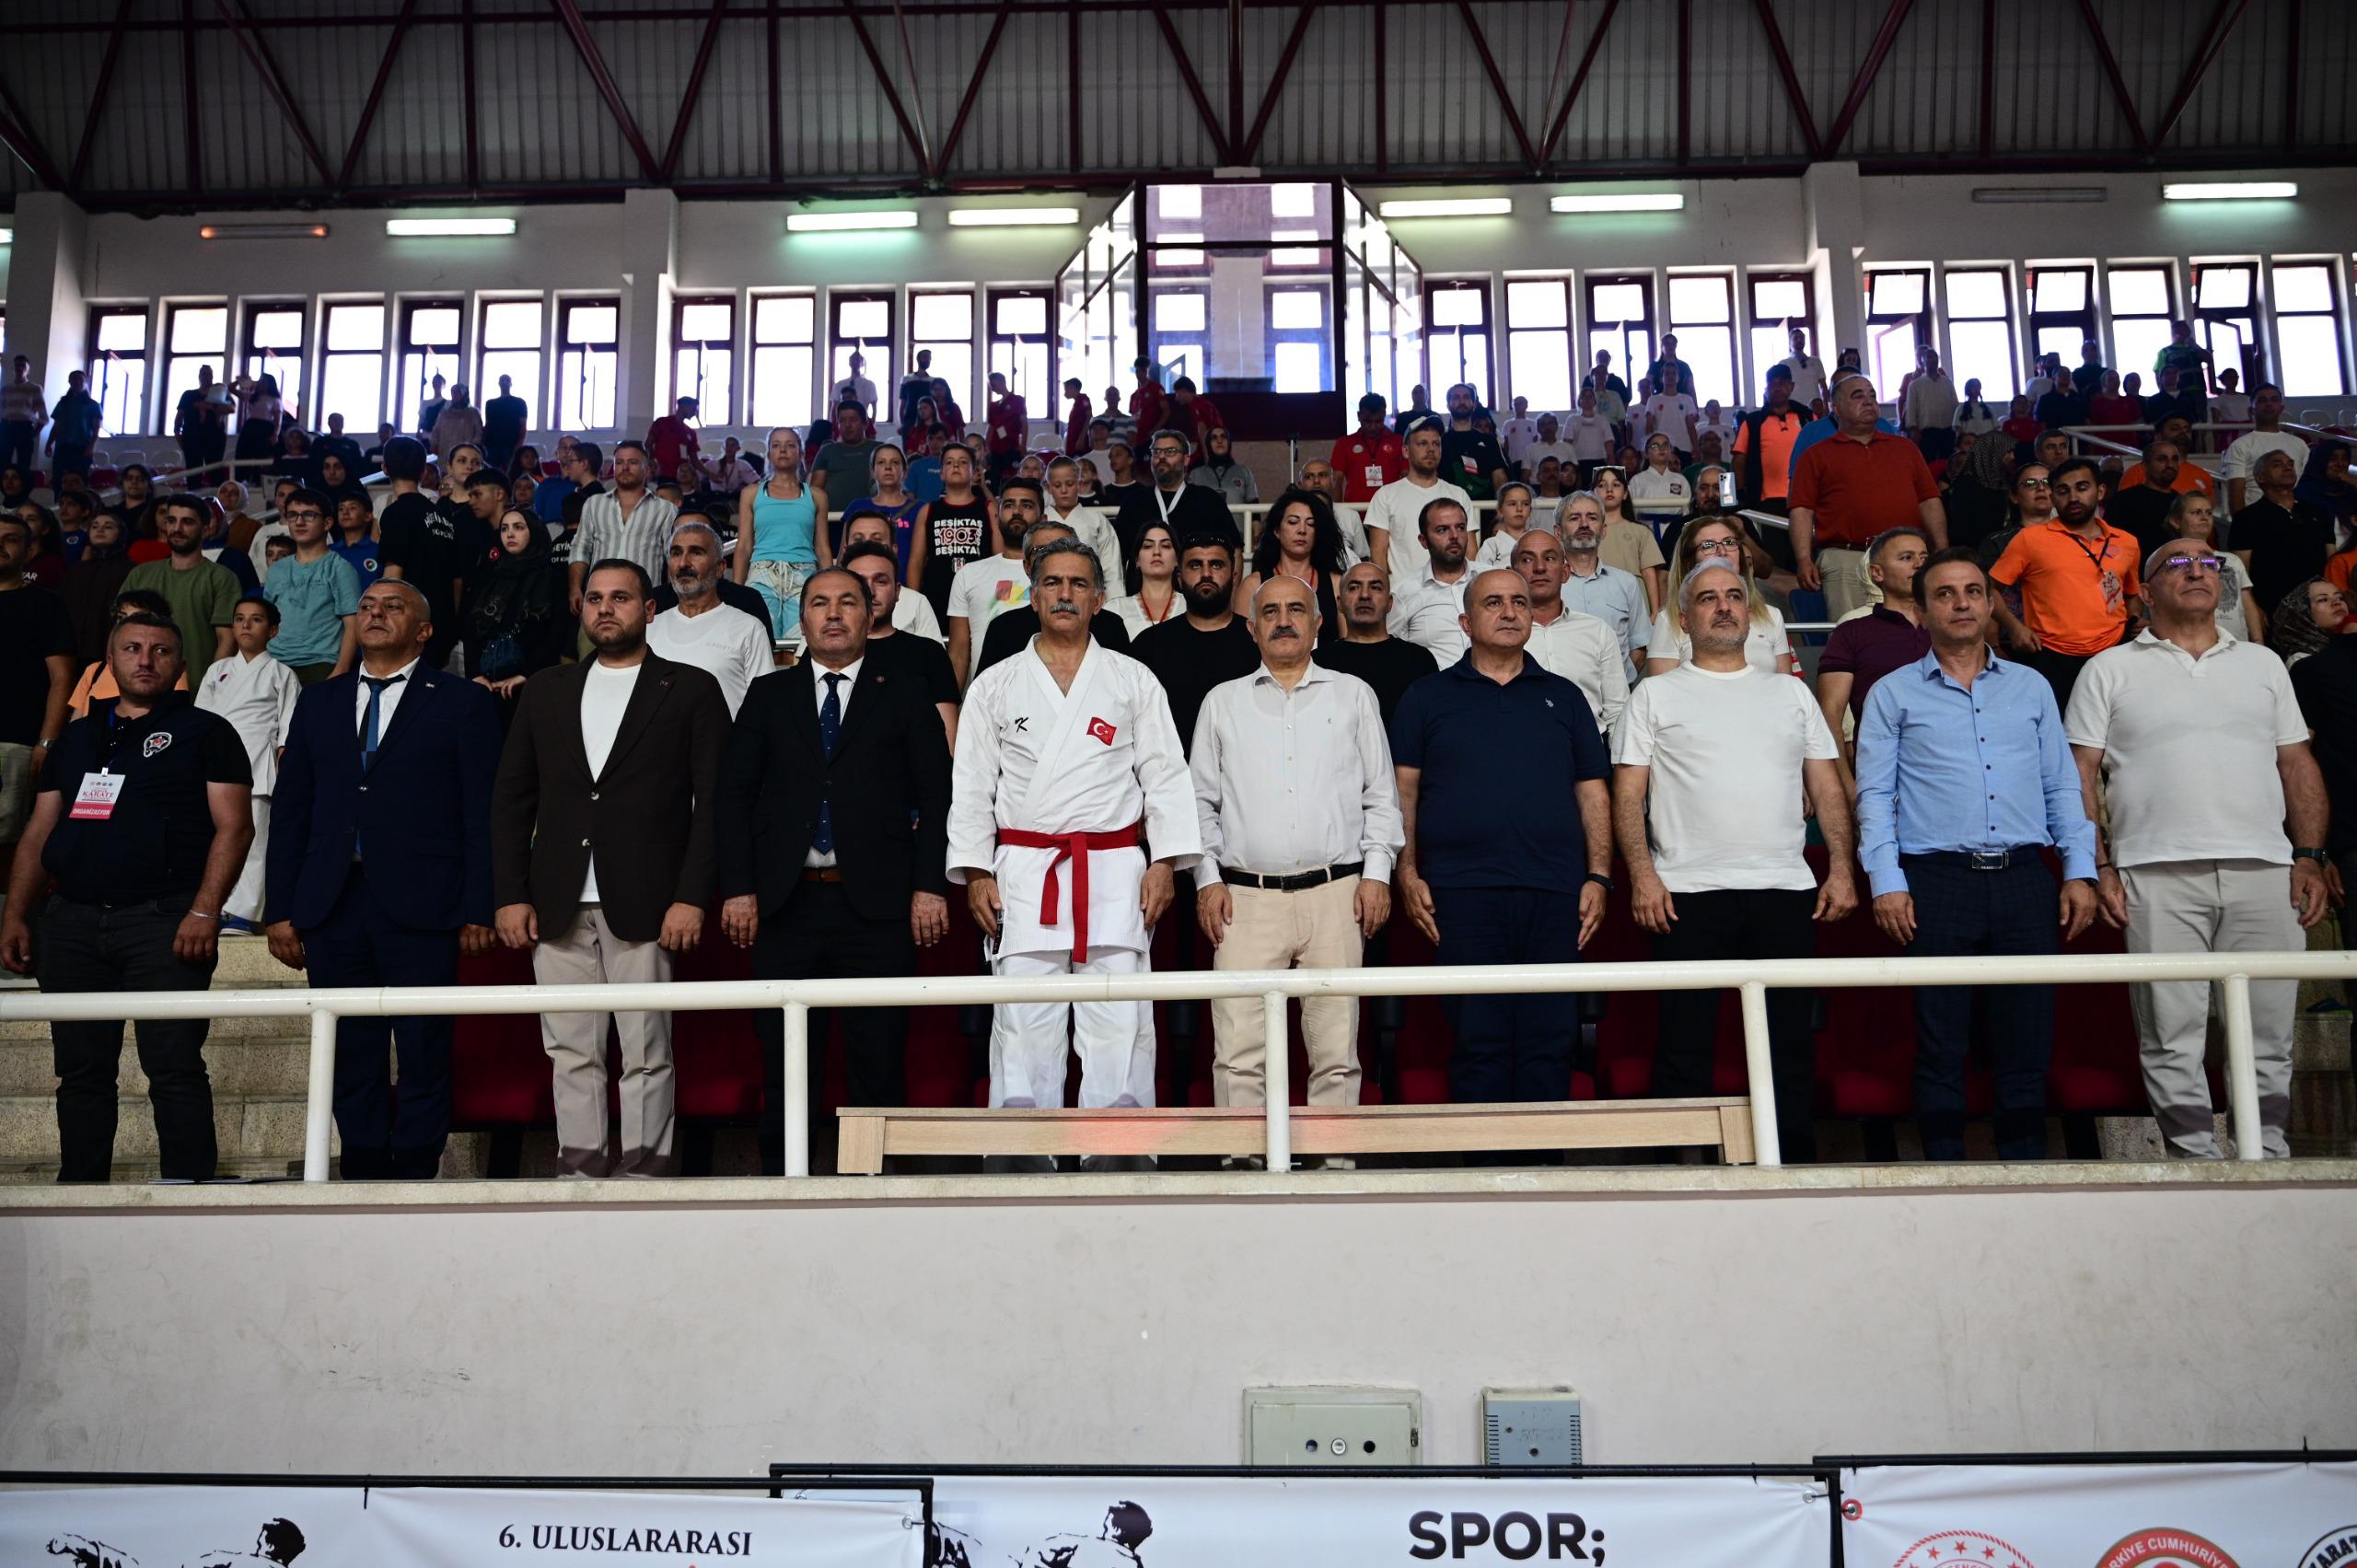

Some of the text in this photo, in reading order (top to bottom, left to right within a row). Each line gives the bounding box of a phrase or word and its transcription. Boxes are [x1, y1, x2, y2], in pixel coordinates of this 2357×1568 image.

[939, 528, 978, 545] 1903
[498, 1524, 753, 1556] 6. ULUSLARARASI
[1408, 1510, 1606, 1568] SPOR;
